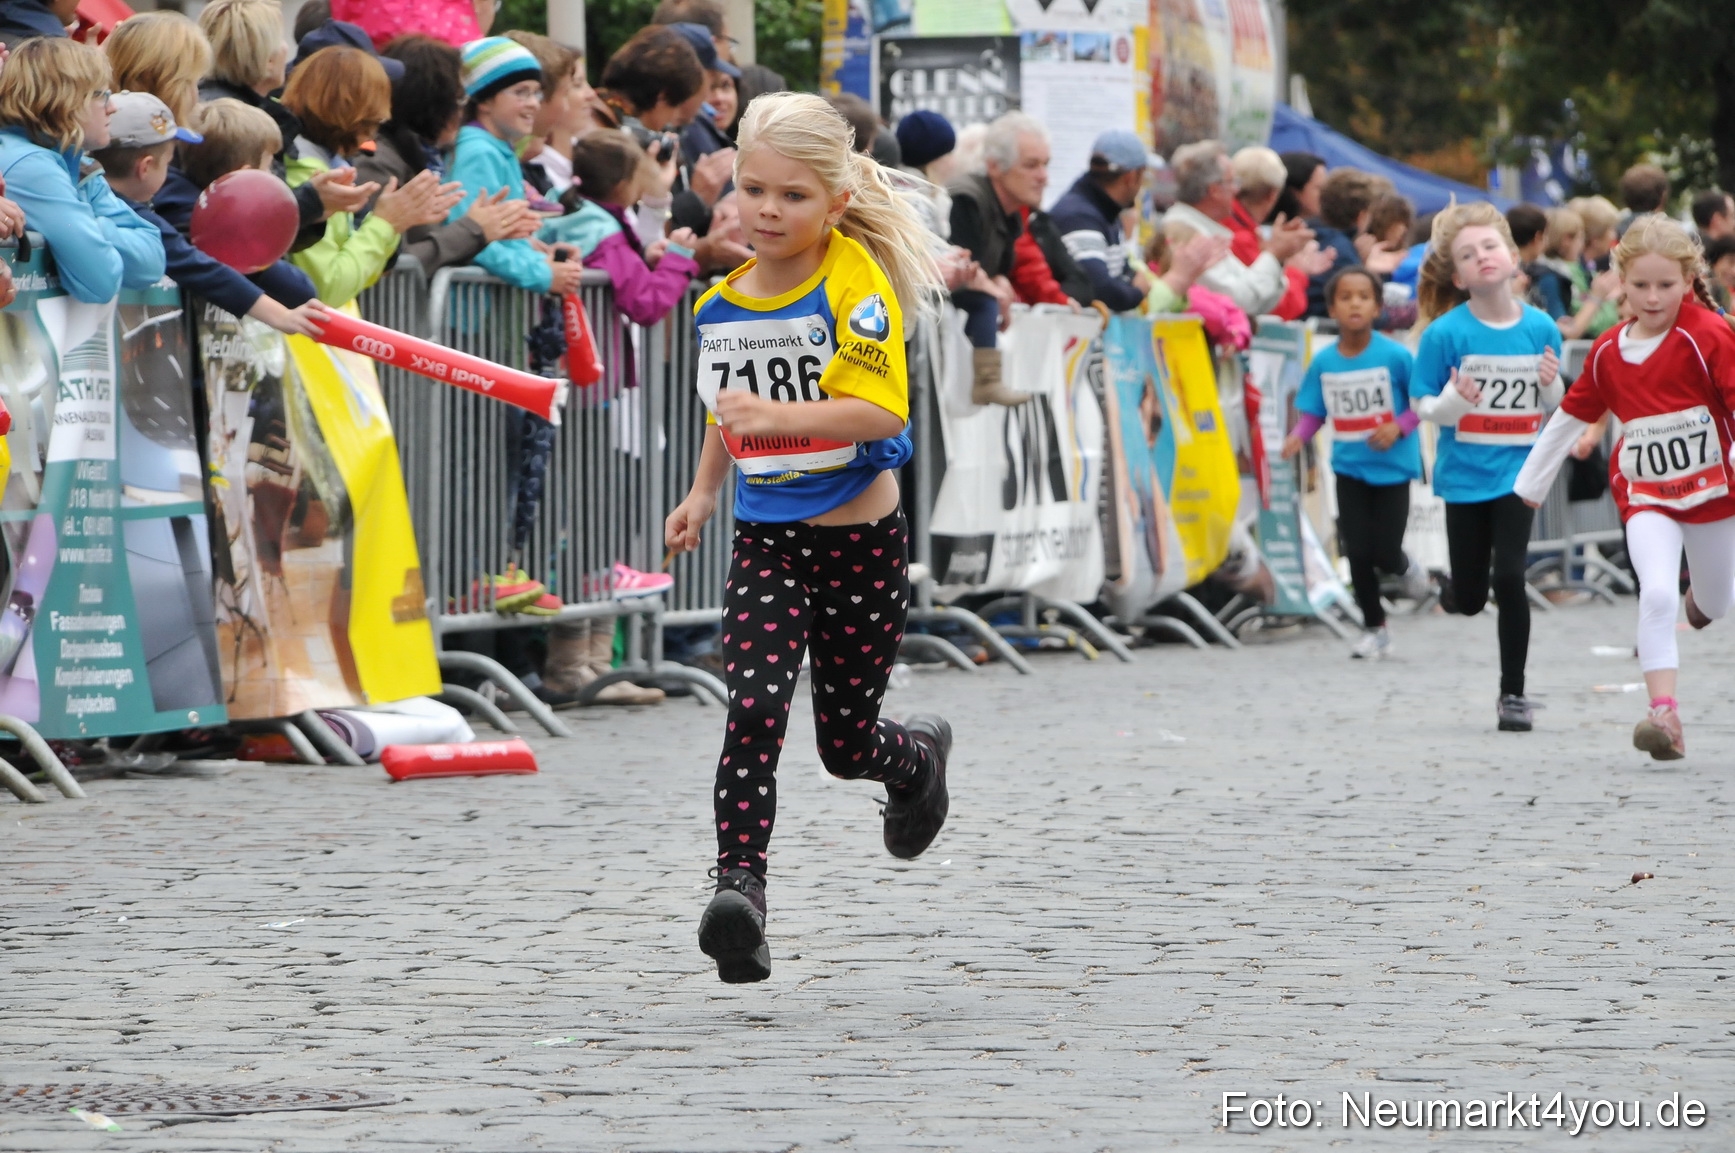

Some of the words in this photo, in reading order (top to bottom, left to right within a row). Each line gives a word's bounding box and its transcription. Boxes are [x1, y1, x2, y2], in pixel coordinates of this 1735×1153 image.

[889, 68, 1008, 98] GLENN
[702, 338, 736, 353] PARTL
[738, 335, 804, 351] Neumarkt
[842, 340, 891, 368] PARTL
[410, 353, 448, 377] BKK
[838, 350, 888, 379] Neumarkt
[450, 367, 496, 391] Audi
[711, 354, 829, 404] 7186
[1474, 377, 1540, 409] 7221
[1329, 386, 1385, 414] 7504
[1482, 418, 1528, 432] Carolin
[1647, 419, 1697, 437] Neumarkt
[1627, 430, 1708, 477] 7007
